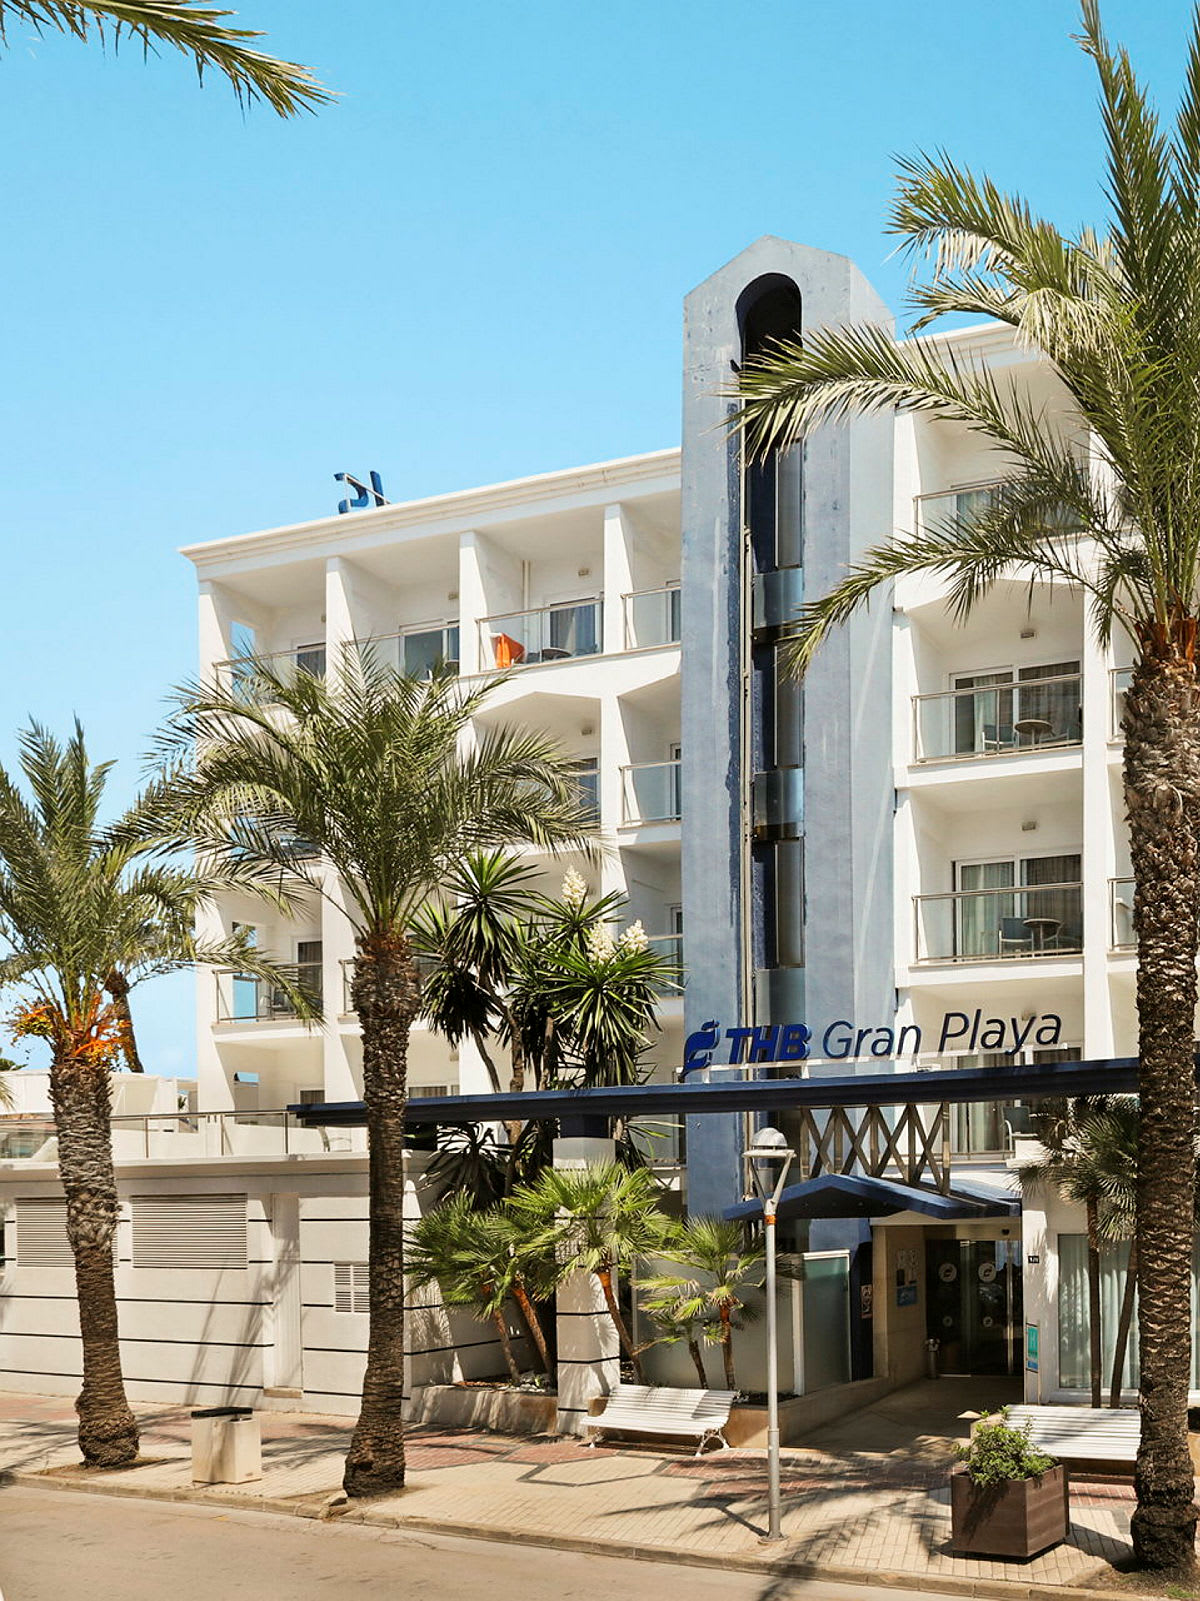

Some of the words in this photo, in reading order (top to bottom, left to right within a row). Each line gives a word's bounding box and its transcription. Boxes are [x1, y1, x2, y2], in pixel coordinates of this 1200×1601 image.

[725, 1022, 812, 1065] THB
[822, 1020, 922, 1061] Gran
[938, 1008, 1062, 1056] Playa
